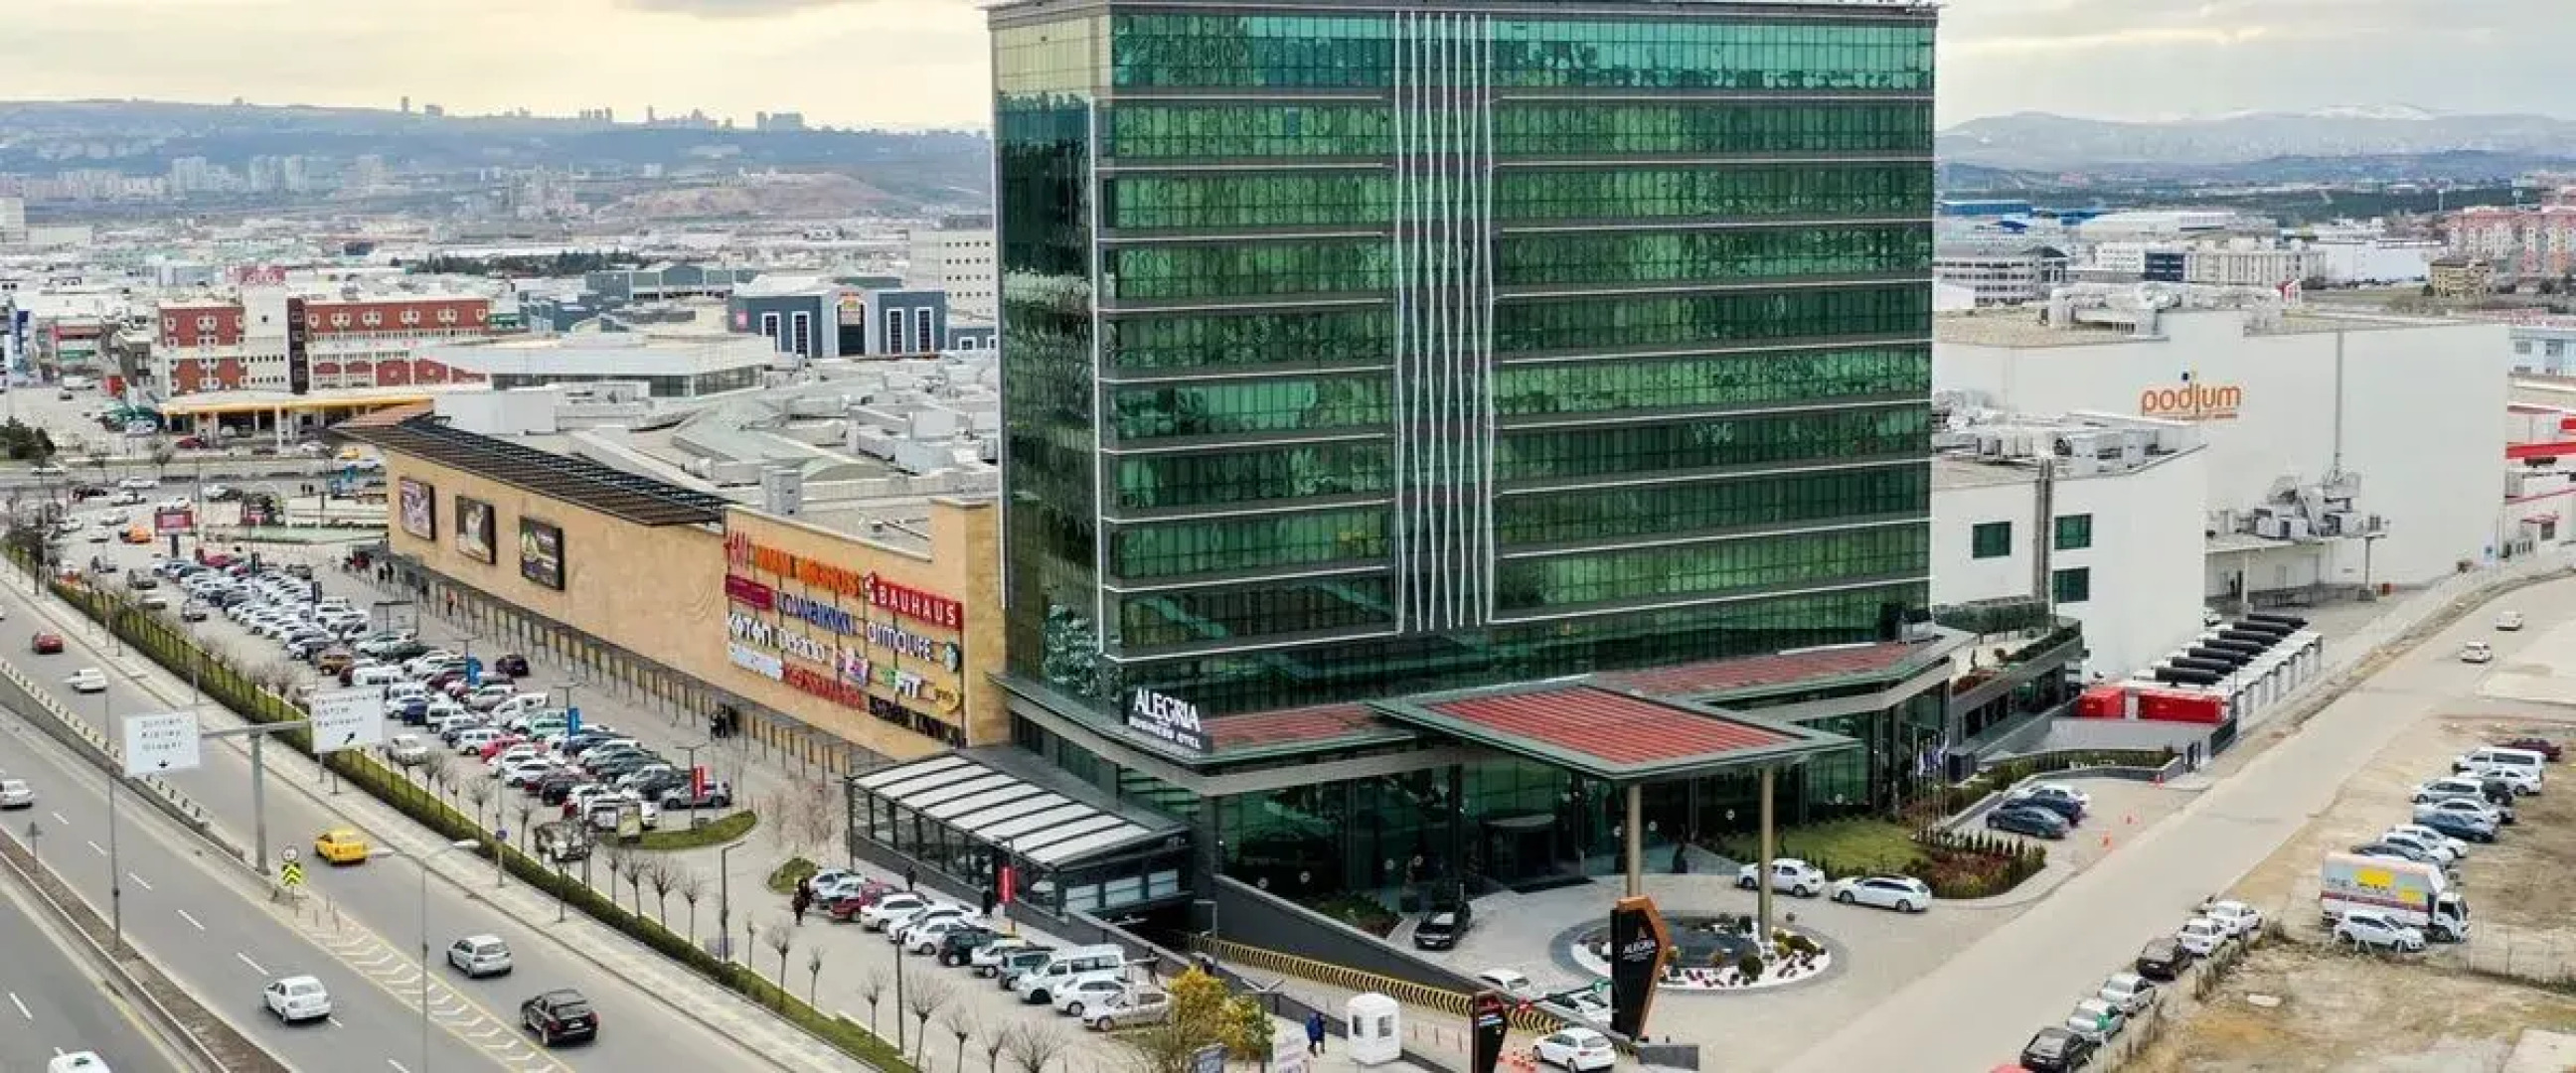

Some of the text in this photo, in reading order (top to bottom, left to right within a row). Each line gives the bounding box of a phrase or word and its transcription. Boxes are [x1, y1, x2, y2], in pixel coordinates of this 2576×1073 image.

[2142, 382, 2241, 416] podium
[878, 584, 956, 626] BAUHAUS
[1133, 686, 1202, 733] ALEGRIA
